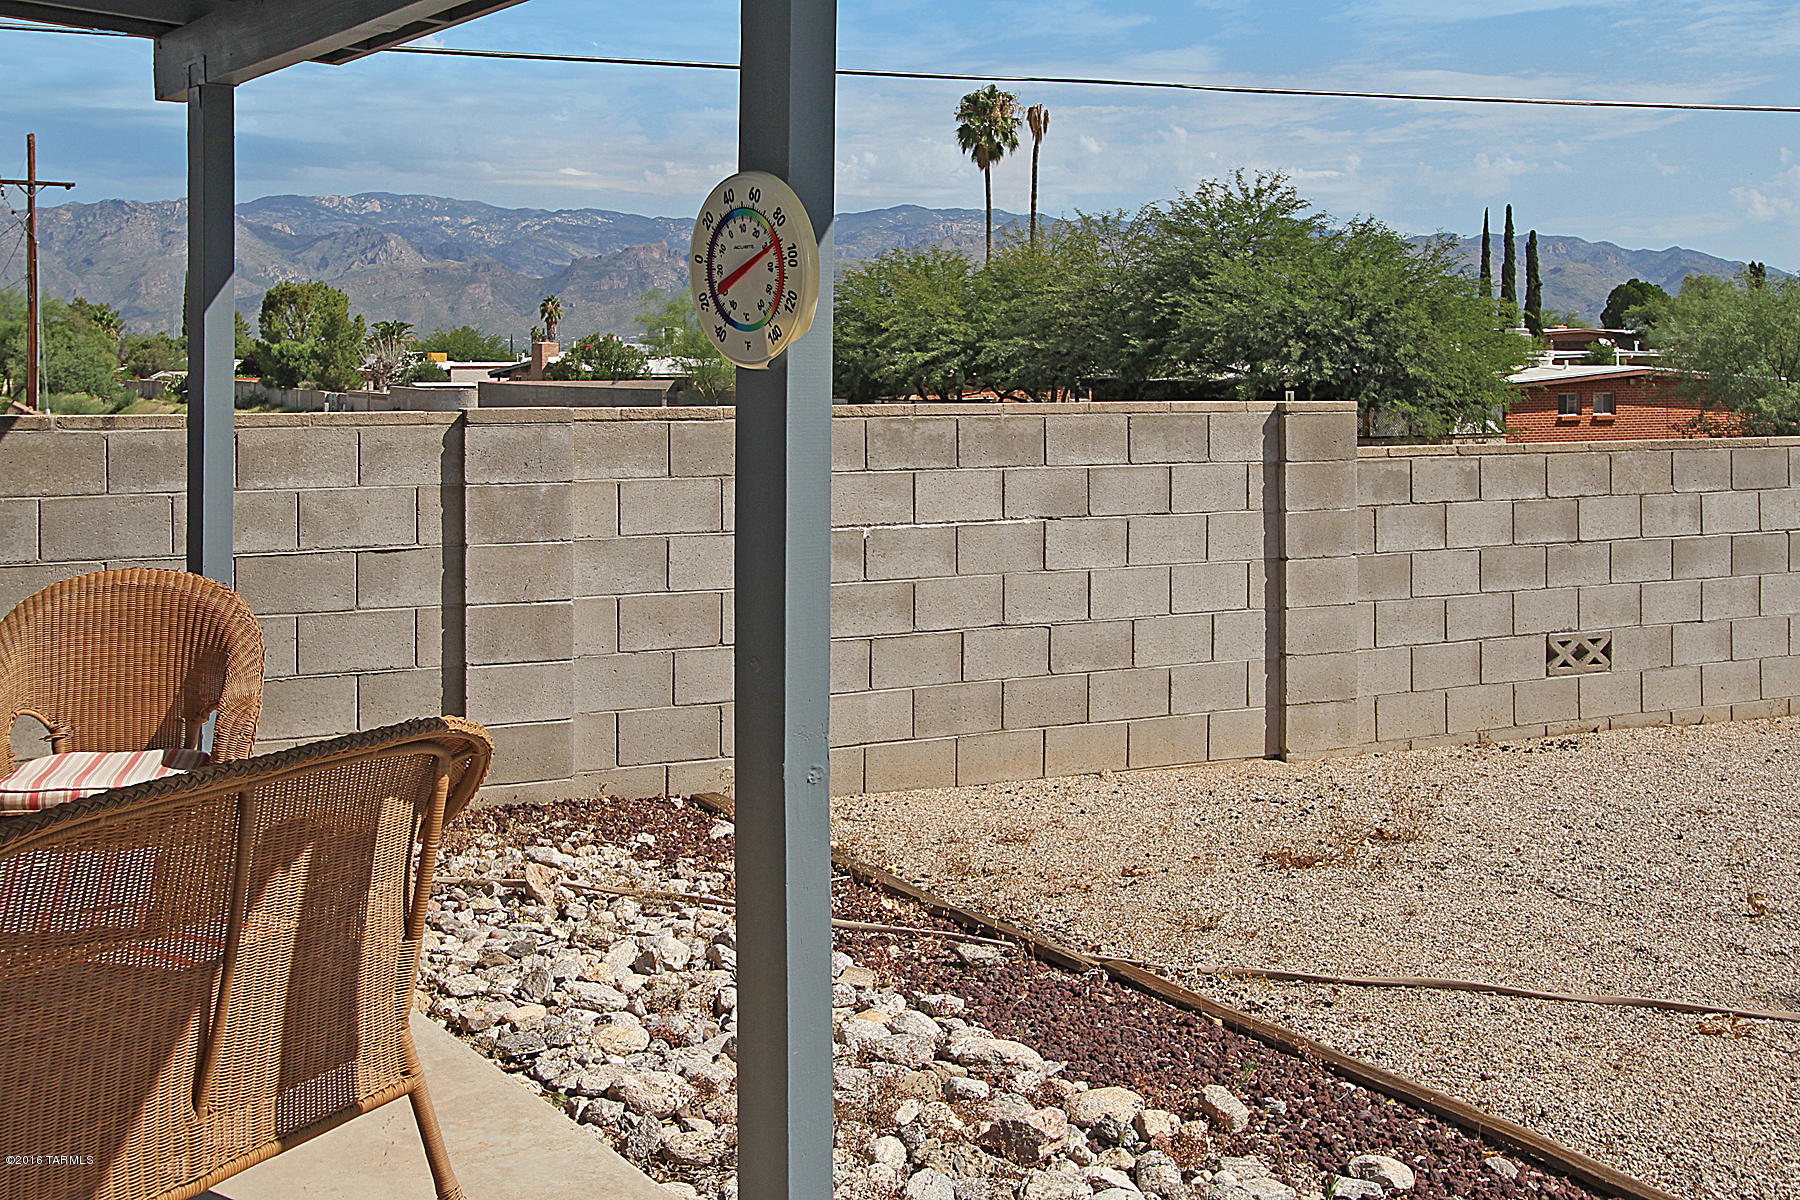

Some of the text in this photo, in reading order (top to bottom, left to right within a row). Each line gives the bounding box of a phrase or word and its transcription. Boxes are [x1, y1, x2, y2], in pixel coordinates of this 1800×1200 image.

[723, 188, 734, 205] 40
[749, 187, 761, 203] 60
[702, 211, 713, 231] 20
[773, 207, 786, 227] 80
[694, 254, 704, 264] 0
[787, 243, 798, 268] 100
[784, 290, 798, 314] 120
[768, 324, 783, 346] 140
